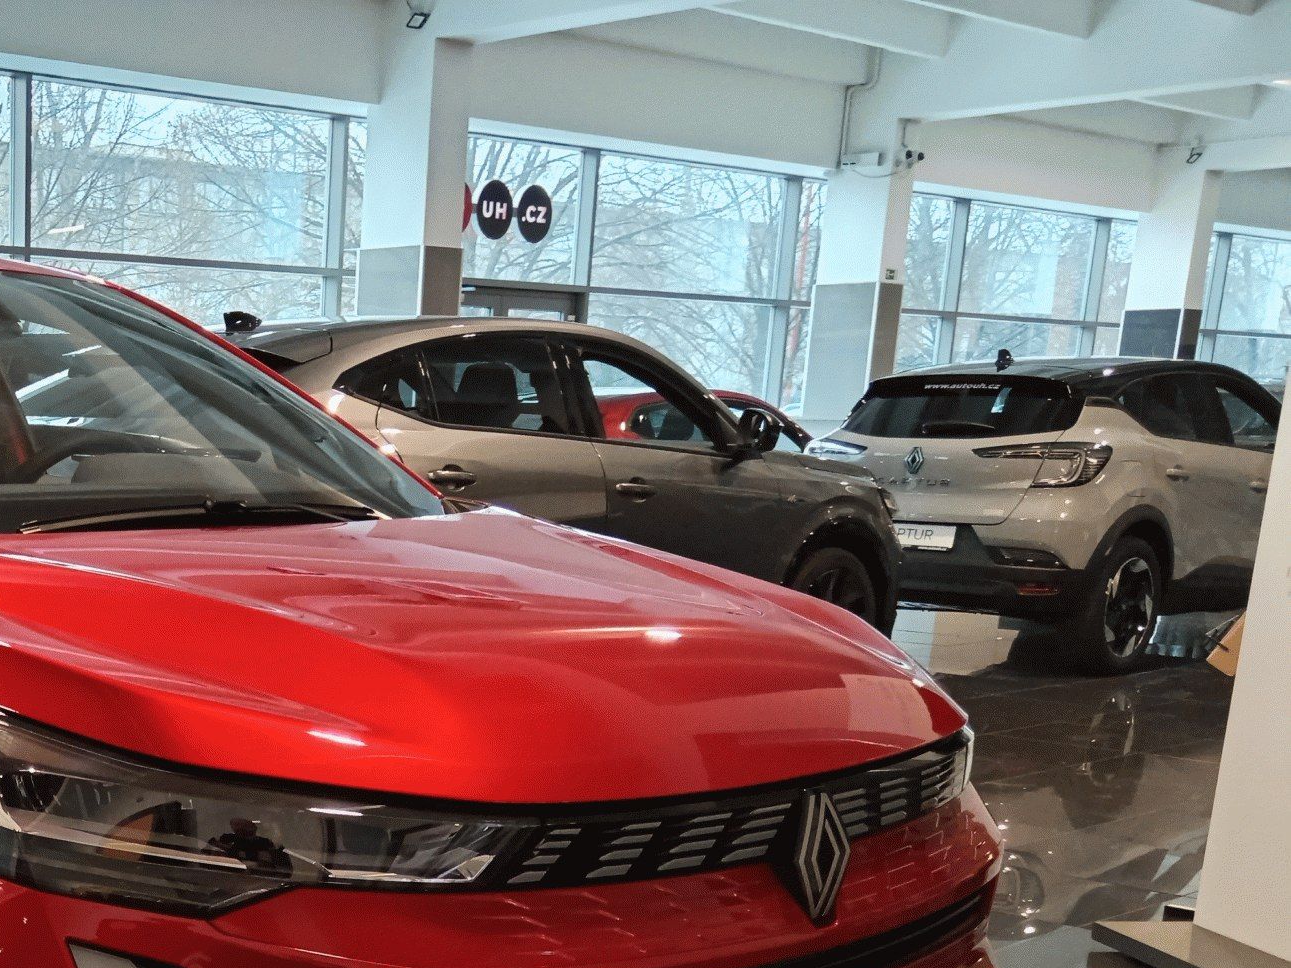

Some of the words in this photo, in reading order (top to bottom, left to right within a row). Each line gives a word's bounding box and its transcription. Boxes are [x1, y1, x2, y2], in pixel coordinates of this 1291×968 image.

[482, 200, 507, 220] UH
[521, 205, 547, 224] .CZ
[897, 528, 934, 541] PTUR
